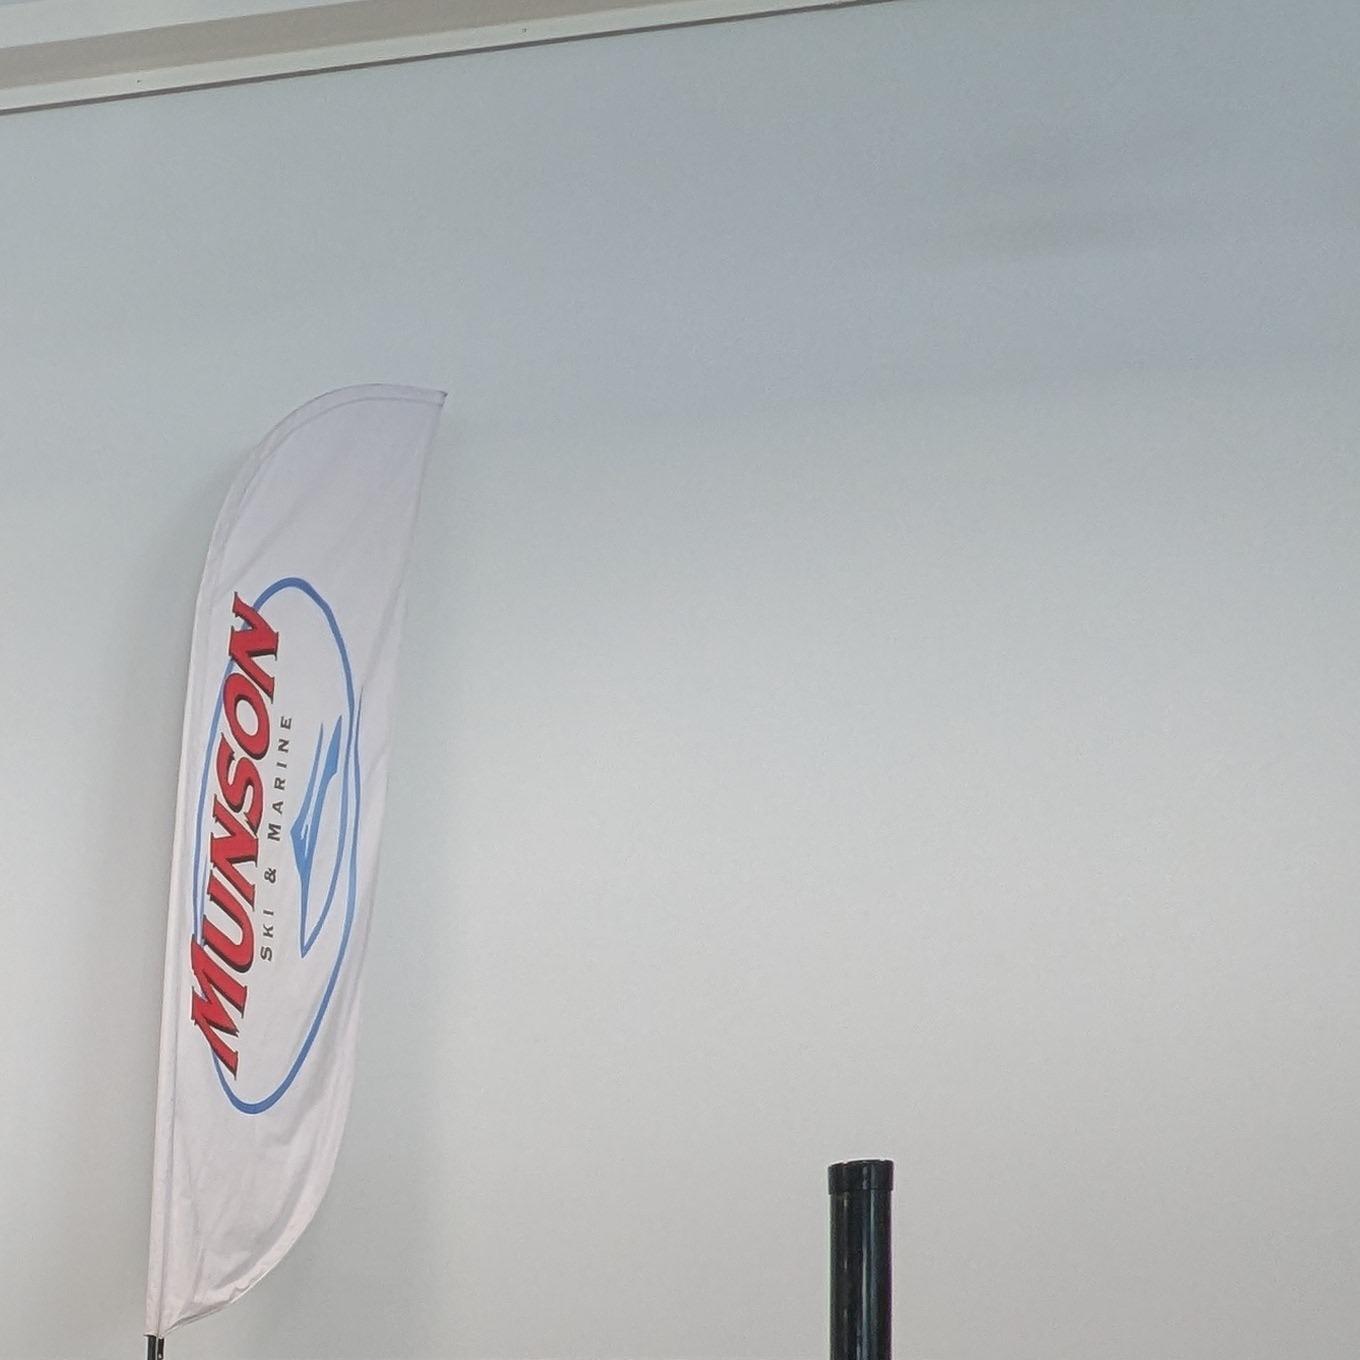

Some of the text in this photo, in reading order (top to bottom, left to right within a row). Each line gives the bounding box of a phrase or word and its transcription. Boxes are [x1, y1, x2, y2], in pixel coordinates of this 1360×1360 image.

[189, 591, 280, 1079] MUNSON
[259, 714, 293, 961] SKI & MARINE
